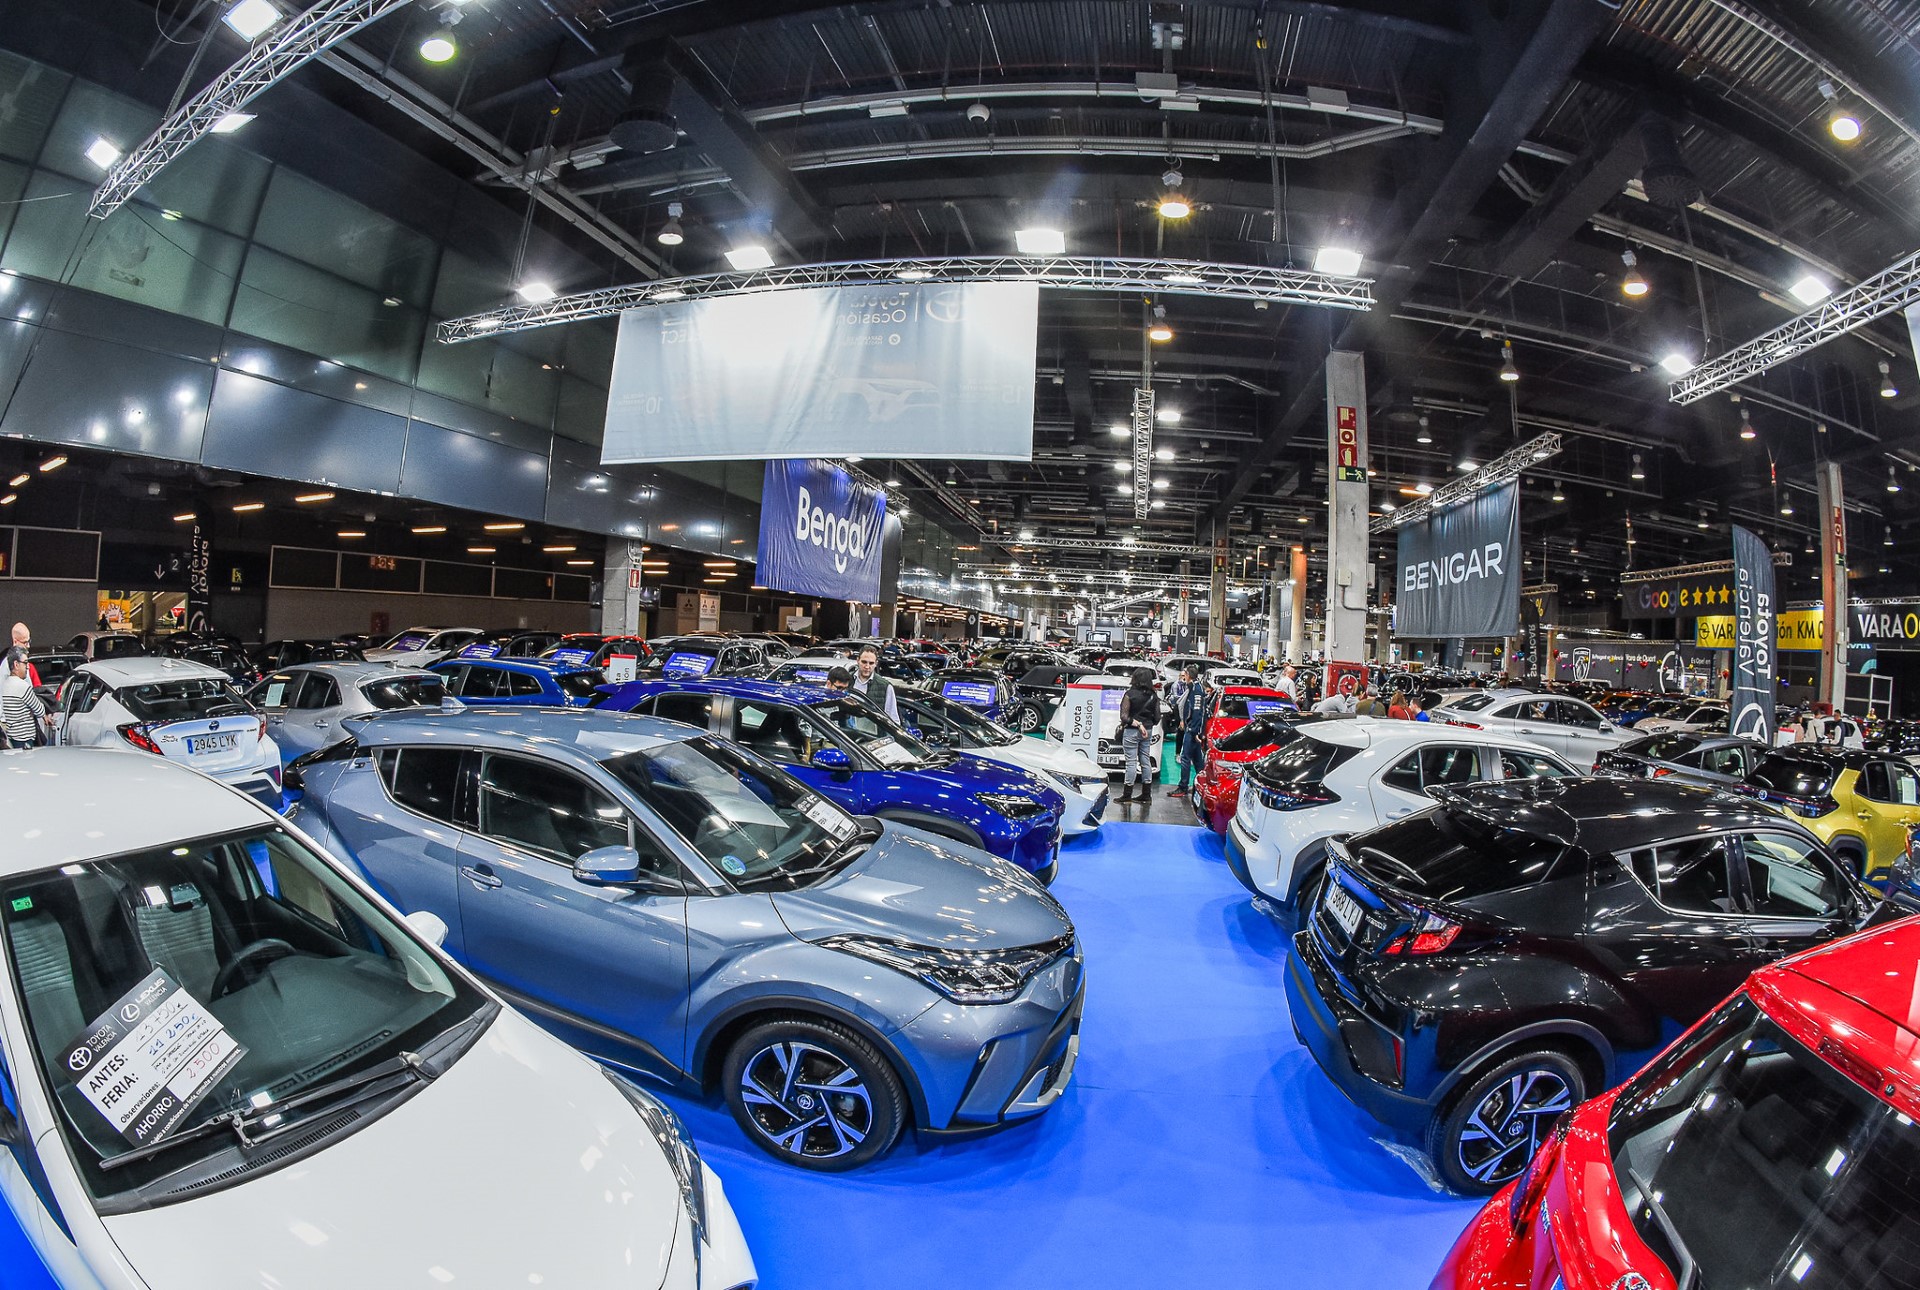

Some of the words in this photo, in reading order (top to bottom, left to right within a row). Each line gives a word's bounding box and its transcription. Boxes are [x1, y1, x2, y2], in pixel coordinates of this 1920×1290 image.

[171, 559, 179, 571] 2
[1404, 542, 1503, 592] BENIGAR
[1639, 584, 1689, 615] Google
[1712, 624, 1736, 640] VAR
[1797, 620, 1815, 639] KM
[1857, 613, 1920, 639] VARAO
[1071, 705, 1082, 738] Toyota
[1083, 699, 1094, 740] Ocasión
[194, 736, 217, 751] 2945
[219, 735, 238, 749] LYK
[135, 977, 165, 1004] LEXUS
[144, 986, 168, 1006] VALENCIA
[86, 1024, 112, 1047] TOYOTA
[93, 1031, 118, 1053] VALENCIA
[89, 1054, 128, 1094] ANTES:
[101, 1073, 139, 1110] FERIA:
[120, 1082, 160, 1124] Observaciones:
[135, 1096, 175, 1140] AHORRO:
